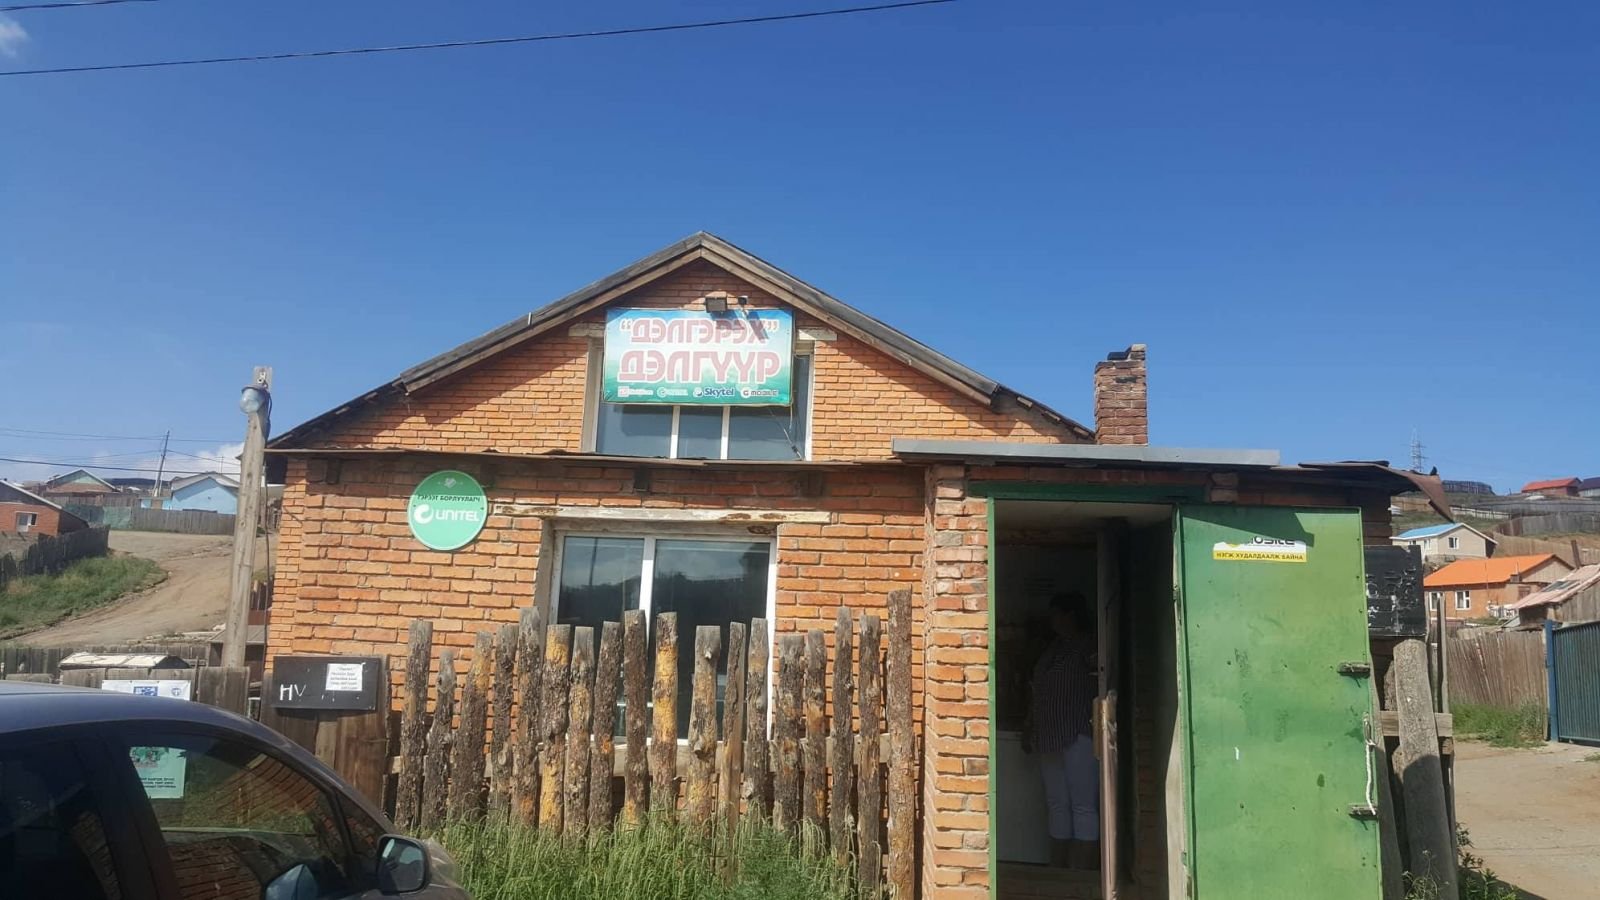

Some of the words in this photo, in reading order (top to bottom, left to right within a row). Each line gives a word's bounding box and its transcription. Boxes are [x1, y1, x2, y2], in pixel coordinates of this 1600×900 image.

[618, 349, 781, 382] ДЭЛГҮҮР
[704, 387, 735, 398] Skytel
[1236, 552, 1280, 560] ХУДАЛДААЛЖ
